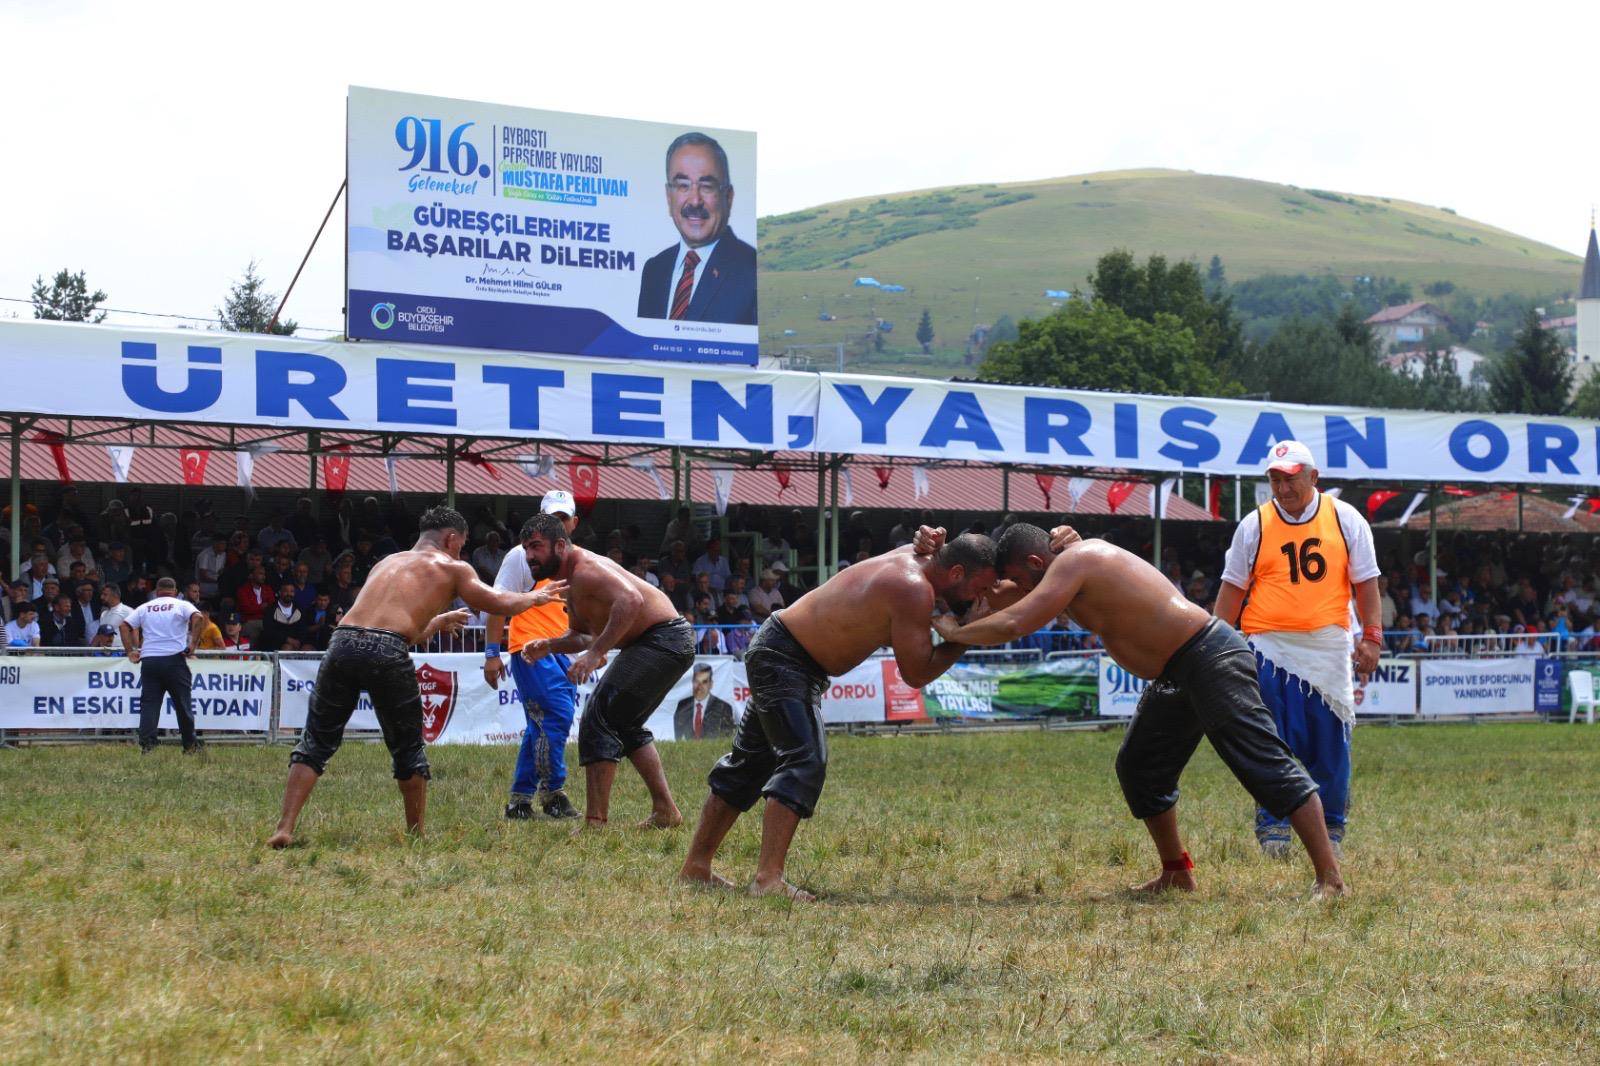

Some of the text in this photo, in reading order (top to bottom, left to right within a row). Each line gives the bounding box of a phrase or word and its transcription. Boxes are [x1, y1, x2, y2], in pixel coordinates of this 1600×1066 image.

[503, 126, 547, 148] AYBASTI
[395, 116, 490, 178] 916.
[560, 153, 602, 174] YAYLASI
[408, 174, 478, 195] Geleneksel
[503, 170, 566, 191] MUSTAFA
[387, 229, 531, 263] BAŞARILAR
[465, 276, 562, 291] Dr. Mehmet Hilmi GÜLER
[416, 306, 436, 314] ORDU
[121, 340, 1600, 475] ÜRETEN, YARIŞAN OR
[1281, 538, 1327, 584] 16
[146, 604, 175, 613] TGGF
[88, 671, 142, 689] BUR
[287, 679, 317, 692] SPO
[1425, 675, 1464, 686] SPORUN
[1465, 674, 1478, 685] VE
[1480, 673, 1532, 685] SPORCUNUN
[832, 684, 876, 699] ORDU
[1454, 687, 1506, 699] YANINDAYIZ
[34, 696, 65, 714] EN
[936, 694, 993, 713] YAYLASI
